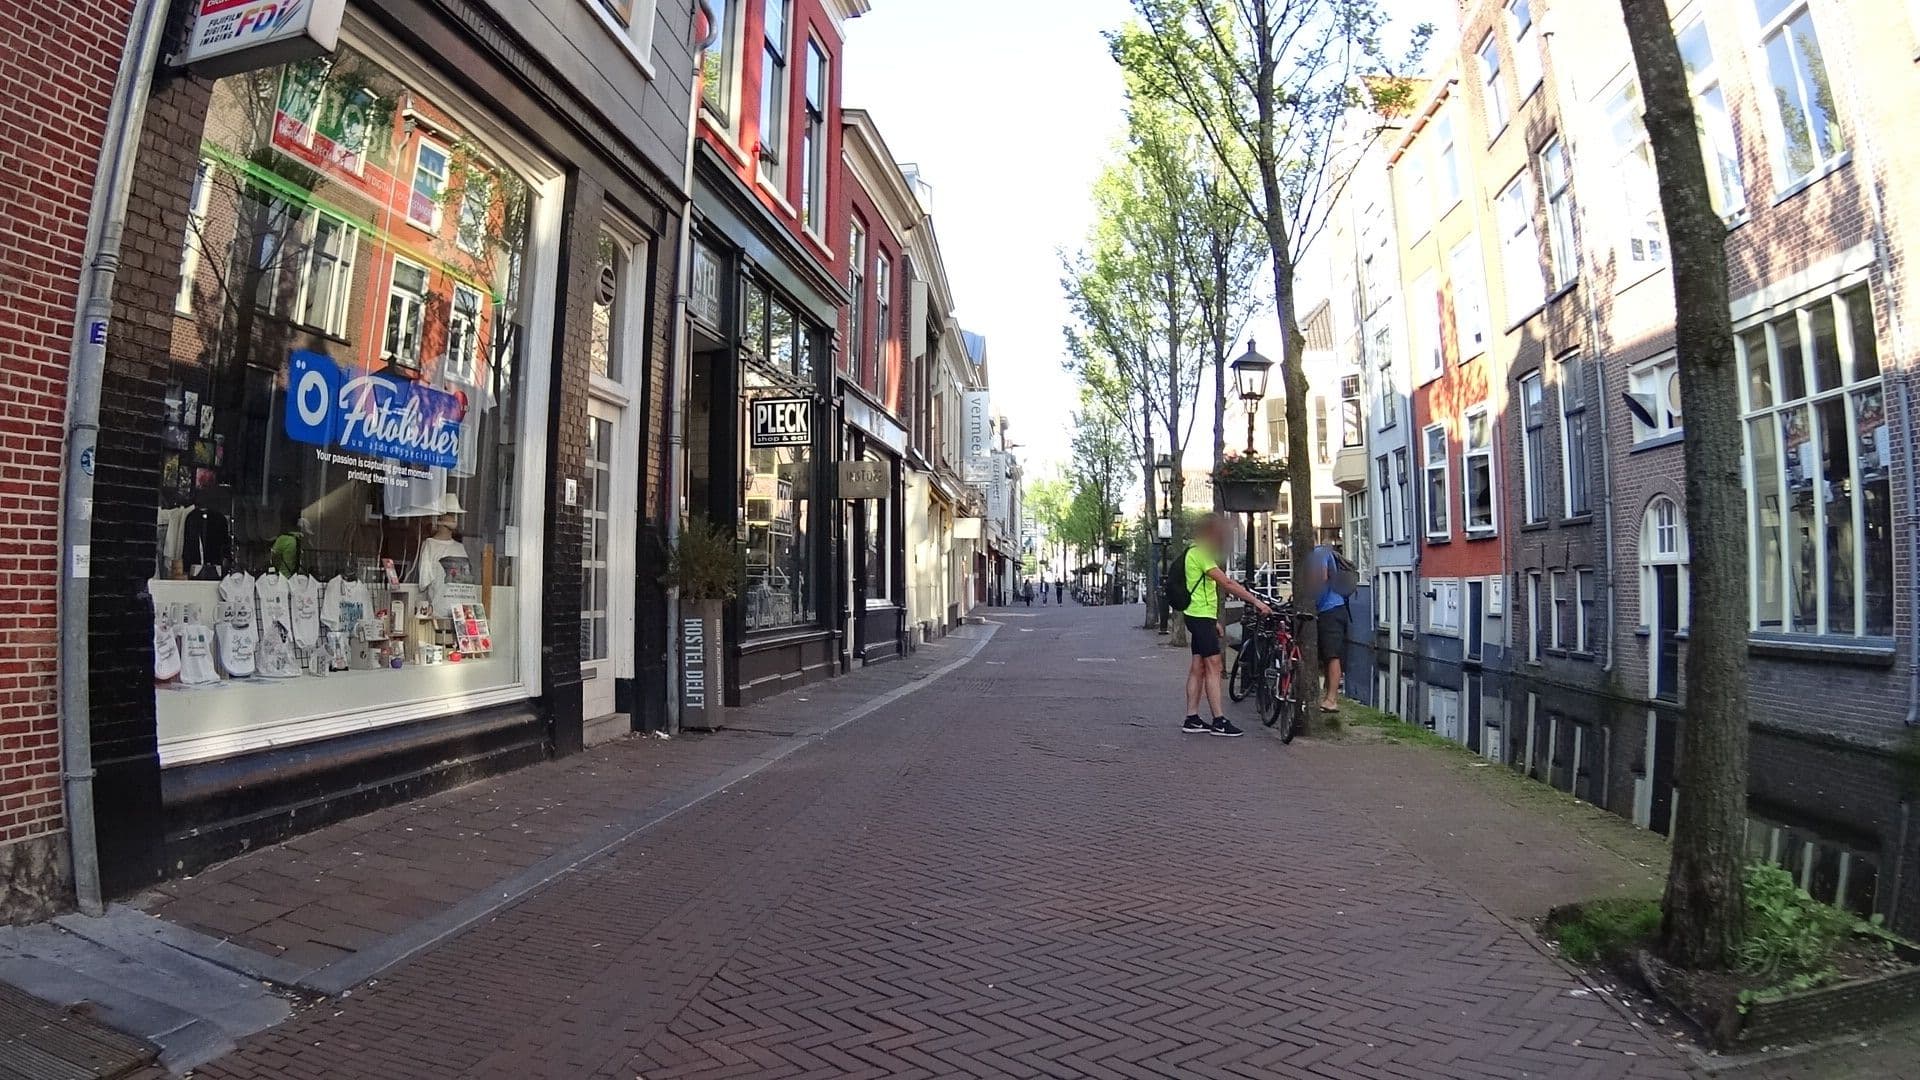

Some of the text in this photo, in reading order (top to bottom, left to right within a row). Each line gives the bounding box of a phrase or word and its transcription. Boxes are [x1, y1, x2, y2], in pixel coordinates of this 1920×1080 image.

[208, 12, 243, 28] FUJIFILM
[199, 31, 234, 47] IMAGING
[203, 23, 233, 38] DIGITAL
[339, 375, 460, 455] Fotobister
[756, 402, 807, 433] PLECK
[757, 435, 780, 443] shop
[316, 448, 434, 480] Your passion is capturing great moments
[347, 470, 409, 488] printing them is ours
[684, 618, 704, 709] HOSTEL DELFT
